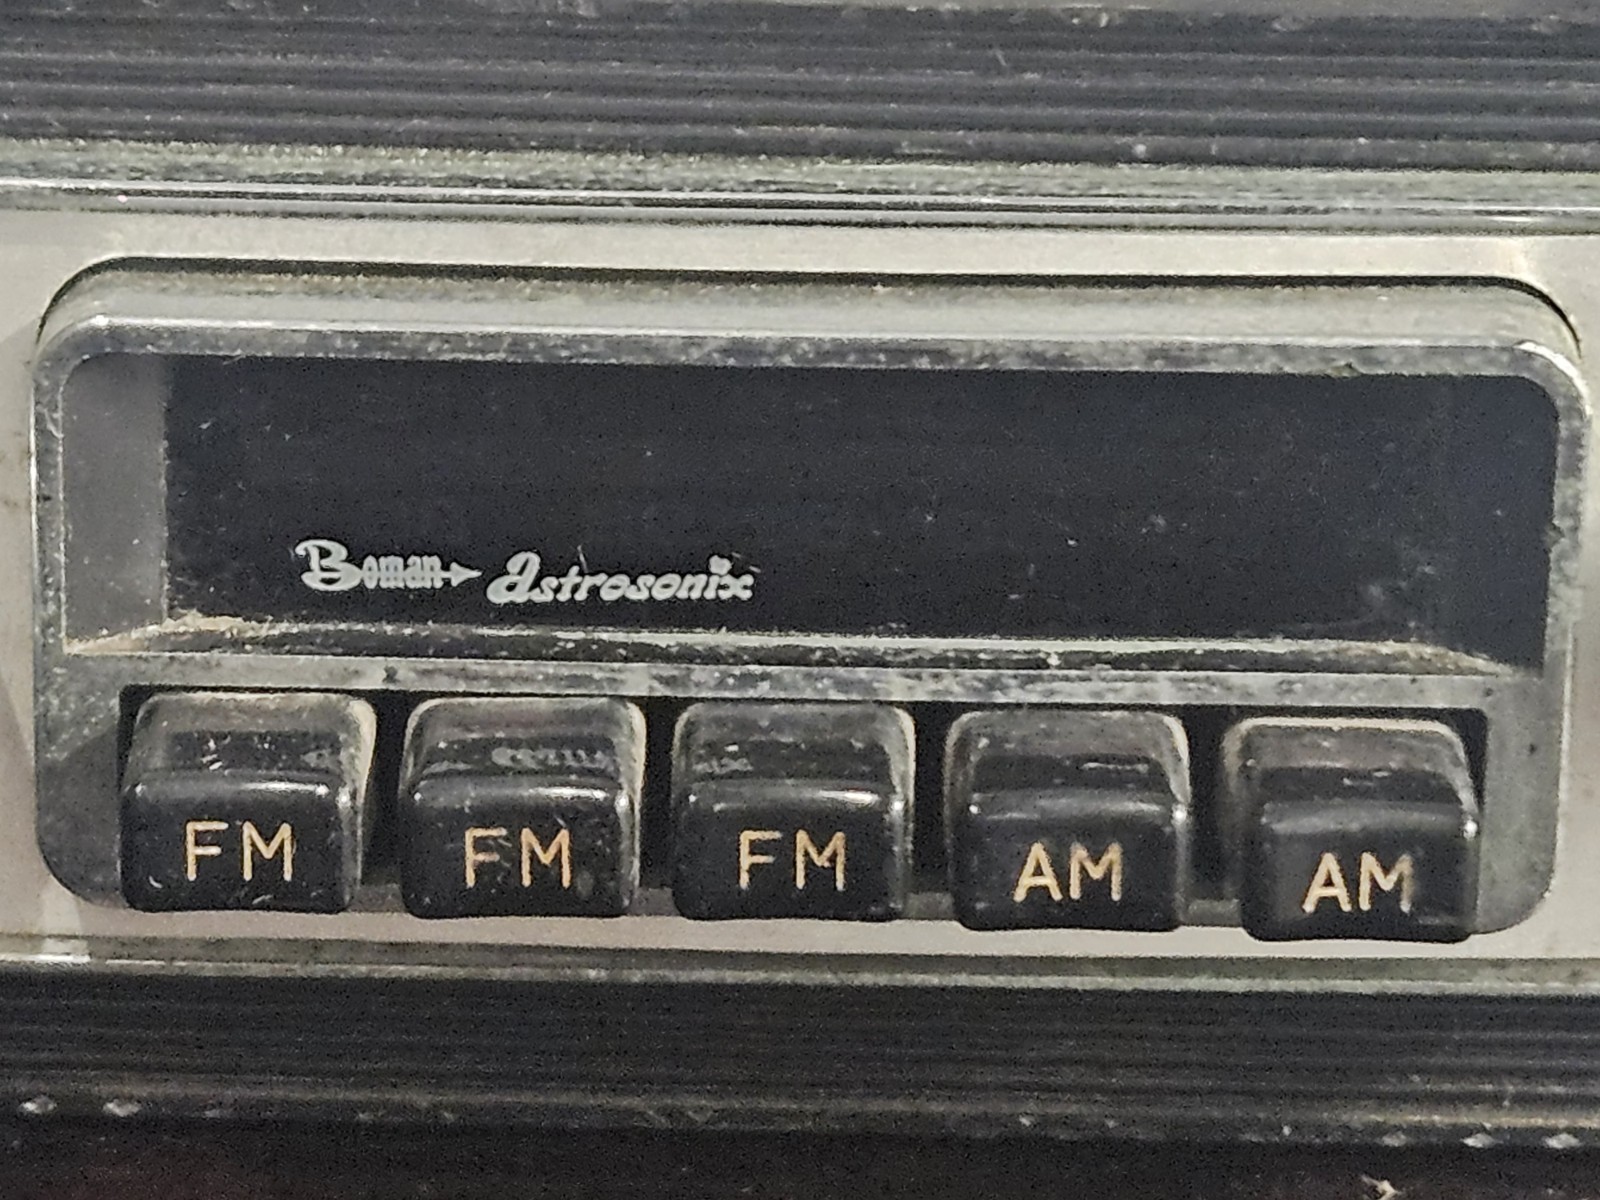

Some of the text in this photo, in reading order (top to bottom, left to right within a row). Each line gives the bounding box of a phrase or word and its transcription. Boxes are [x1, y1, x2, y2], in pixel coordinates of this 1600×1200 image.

[295, 539, 443, 591] Boman
[184, 820, 293, 882] FM
[464, 827, 571, 888] FM
[737, 829, 847, 893] FM
[1013, 842, 1122, 902] AM
[1302, 852, 1413, 913] AM
